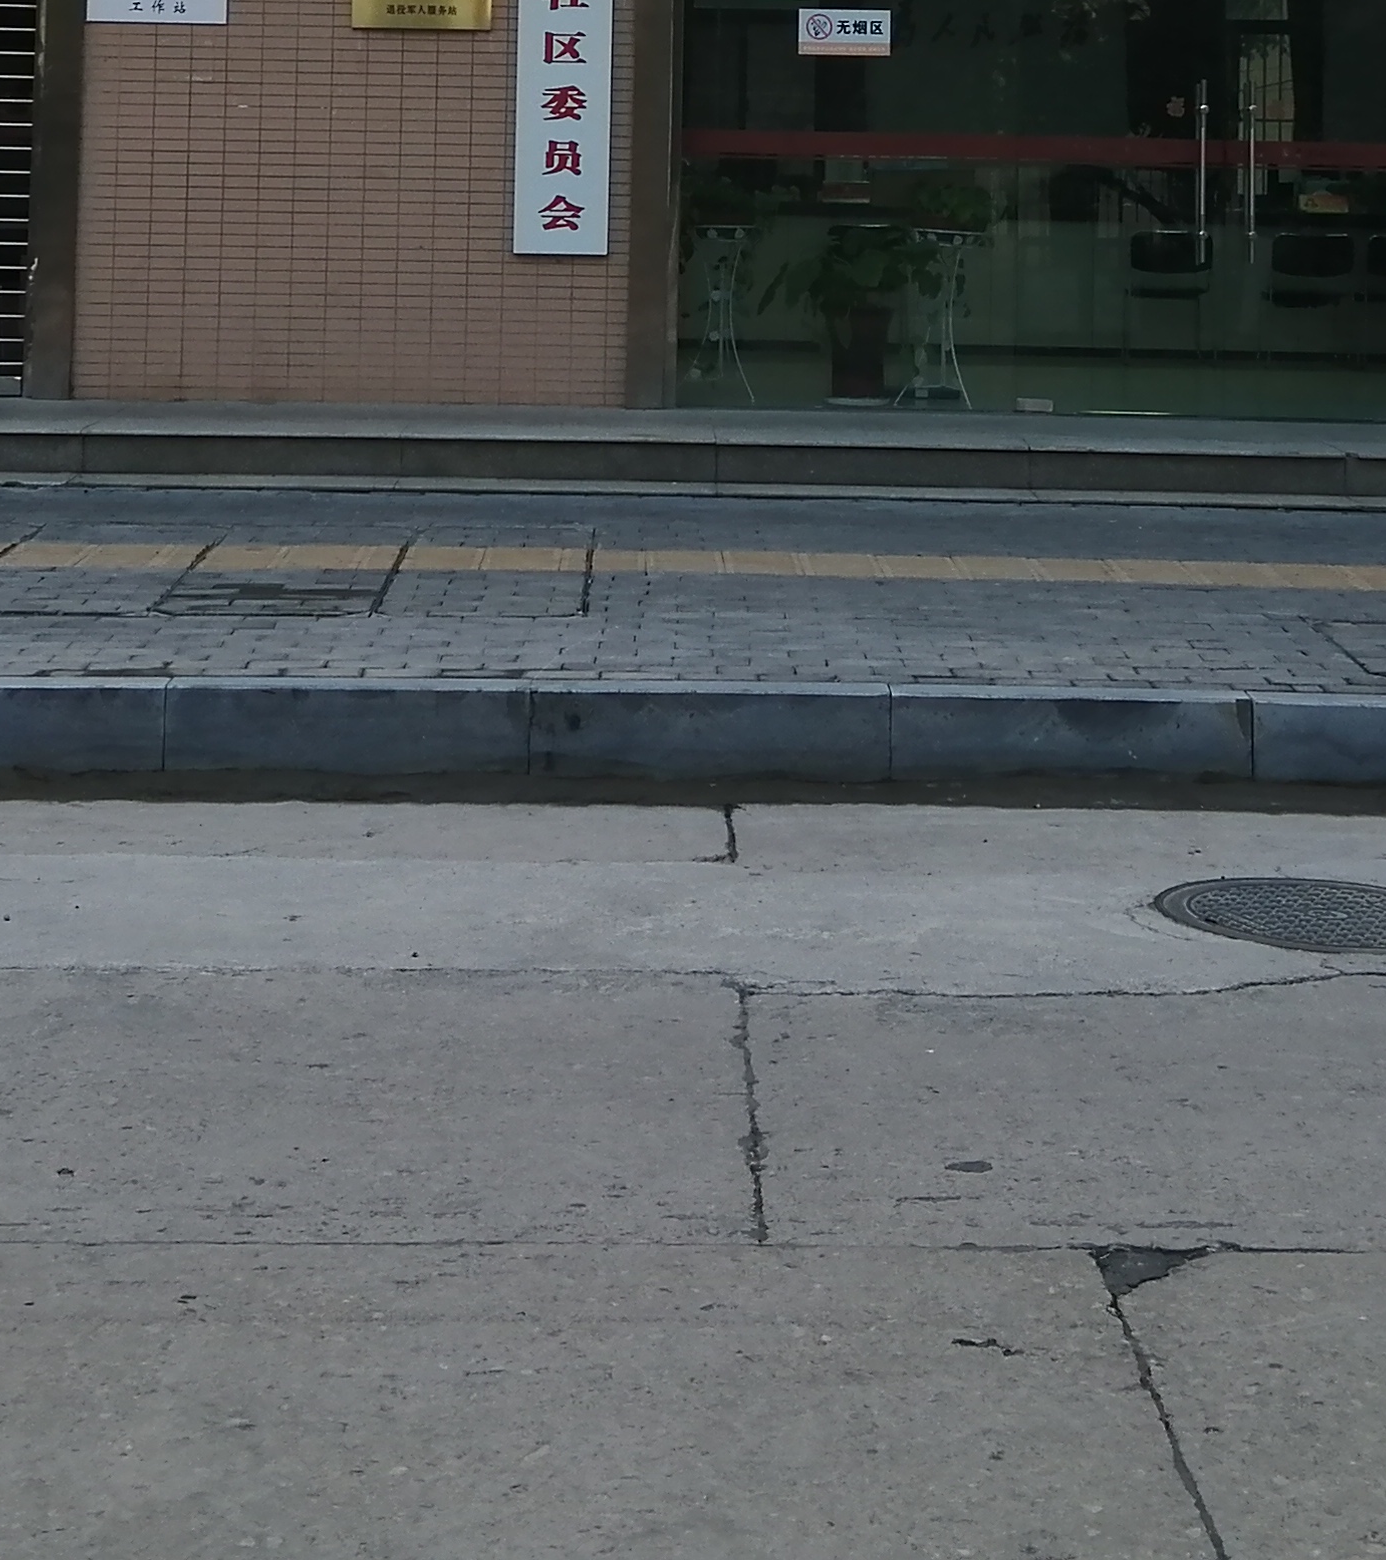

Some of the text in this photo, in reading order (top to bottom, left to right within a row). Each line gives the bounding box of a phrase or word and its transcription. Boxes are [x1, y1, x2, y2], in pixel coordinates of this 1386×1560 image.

[129, 0, 187, 14] 工作站
[386, 4, 458, 16] 退役军人服务站
[836, 20, 883, 34] 无烟区
